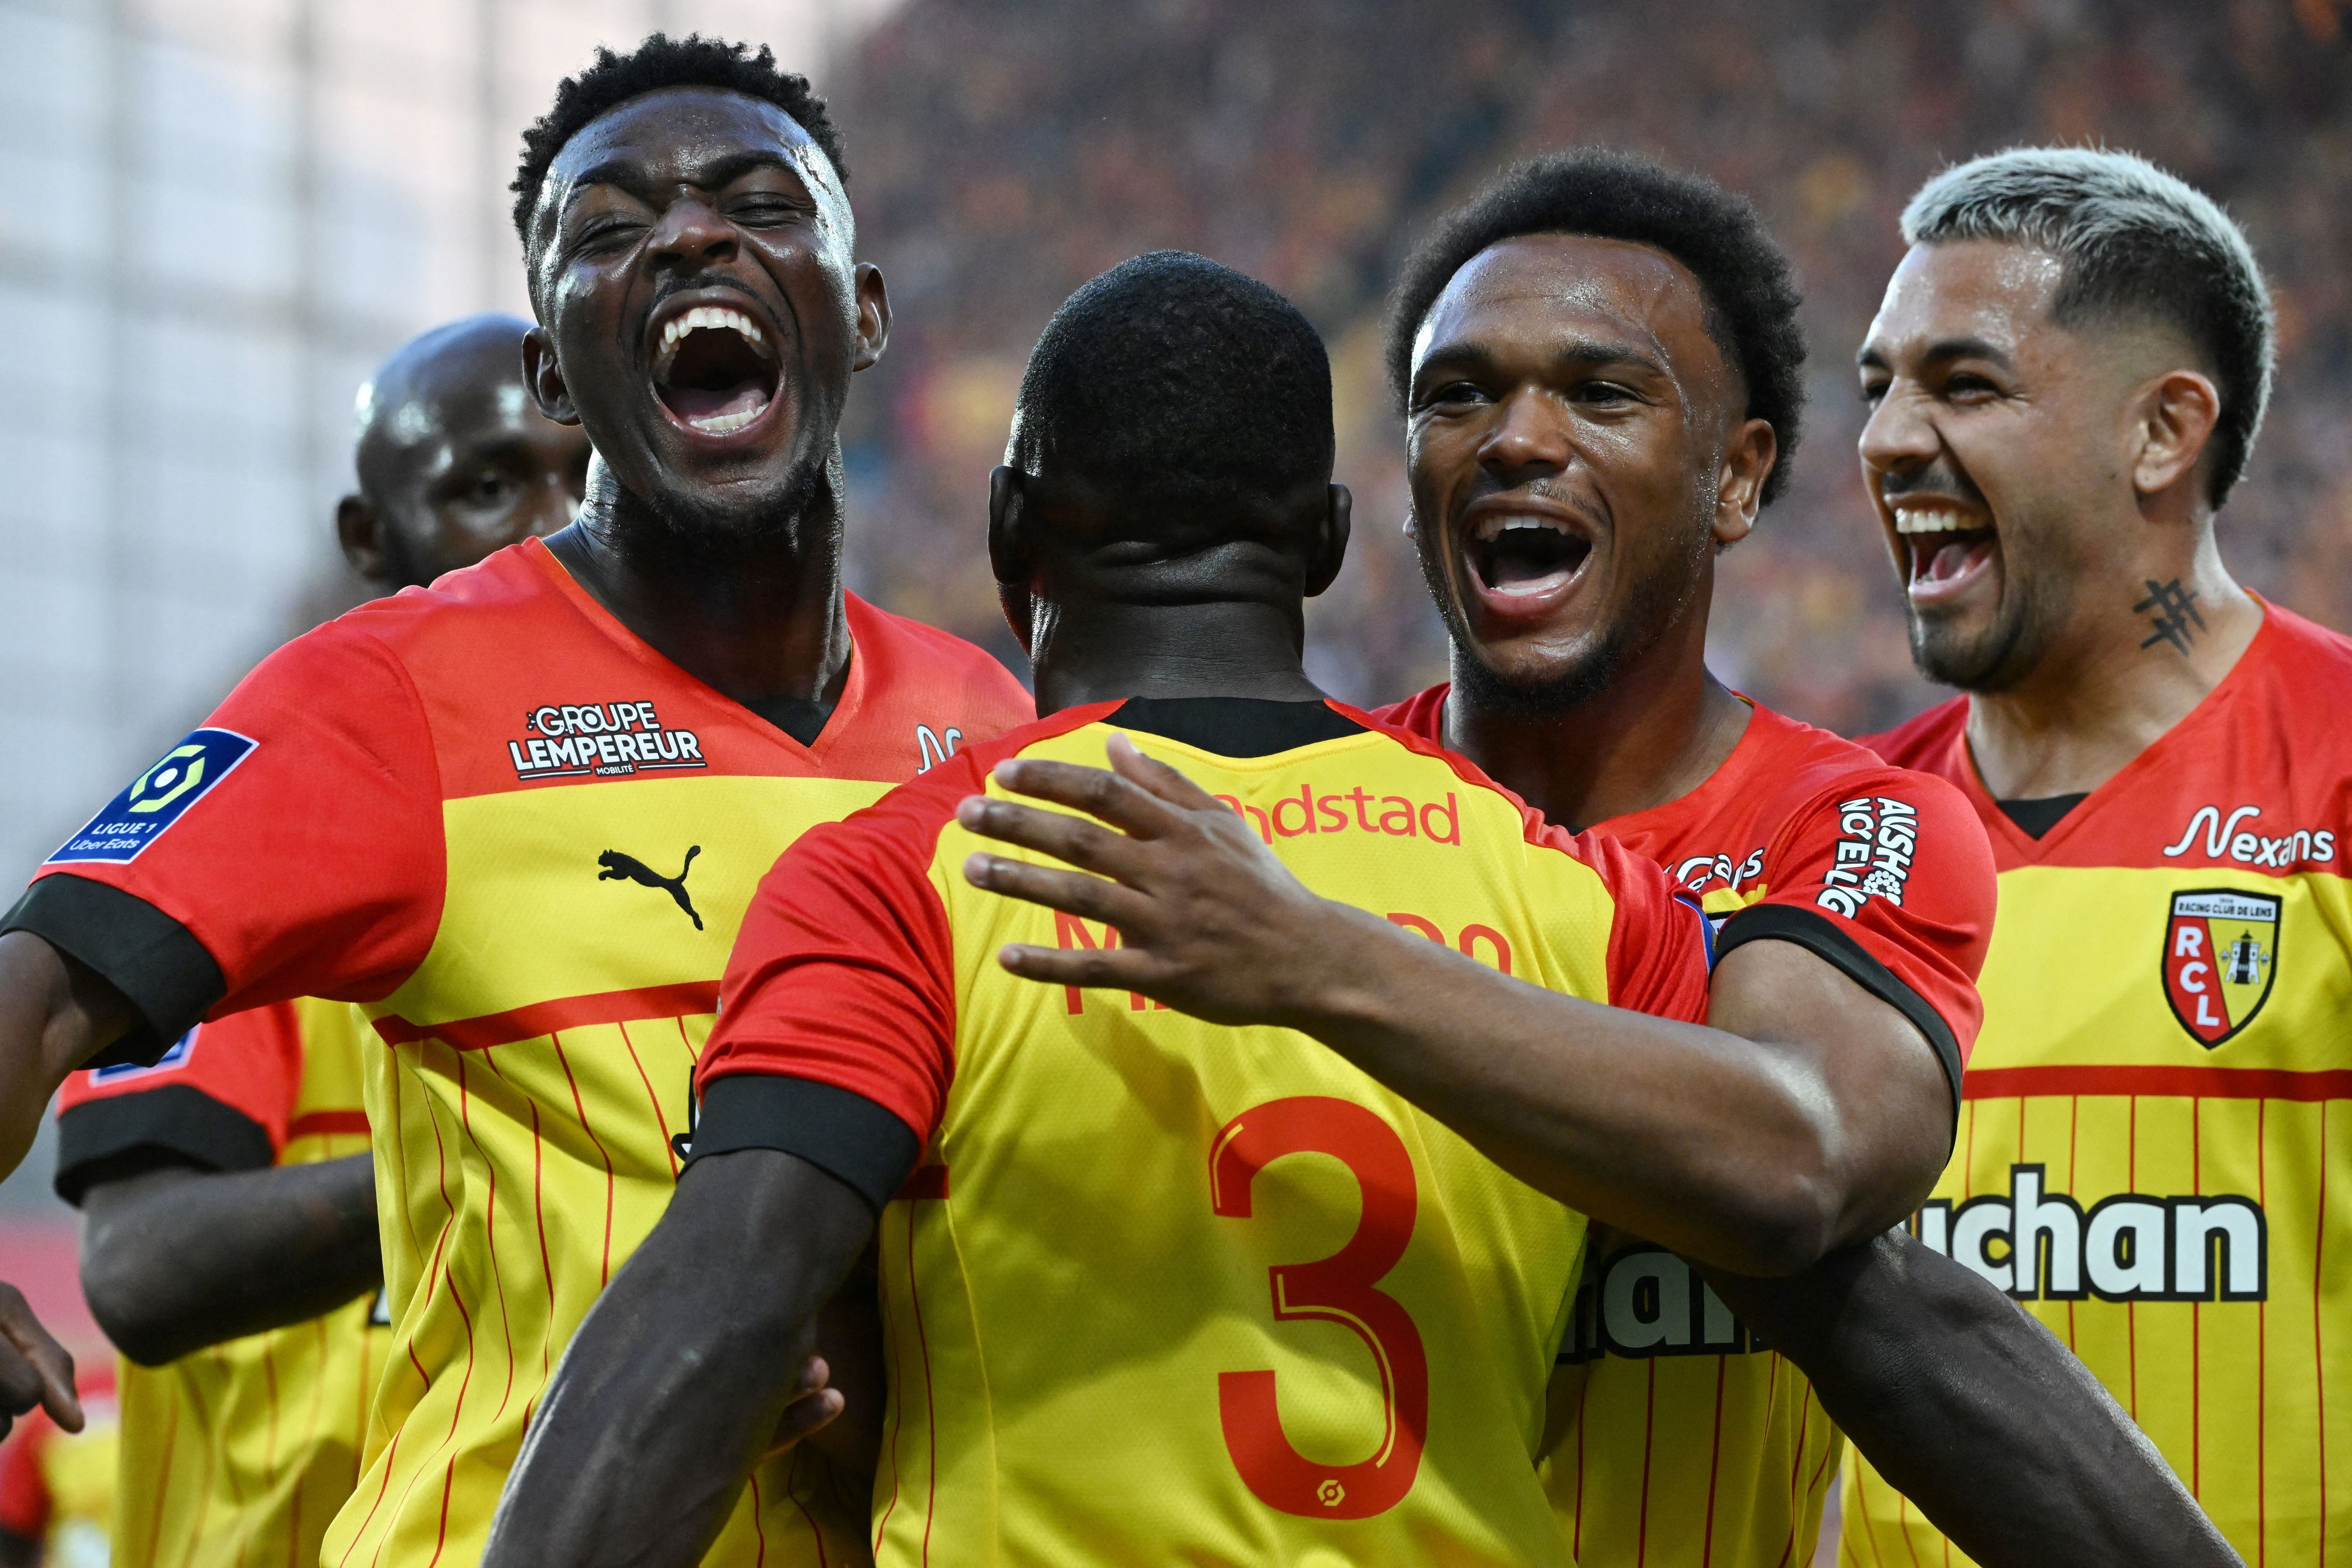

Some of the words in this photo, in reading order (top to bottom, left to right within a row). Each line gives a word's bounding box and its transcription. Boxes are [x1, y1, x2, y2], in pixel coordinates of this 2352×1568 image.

[534, 702, 660, 735] GROUPE
[509, 731, 703, 771] LEMPEREUR
[595, 764, 634, 775] MOBILITÉ
[91, 823, 146, 835] LIGUE
[145, 823, 158, 834] 1
[2163, 805, 2334, 868] Nexans
[69, 840, 107, 851] Uber
[102, 838, 141, 850] Eats
[2179, 902, 2211, 913] RACING
[2213, 904, 2235, 915] CLUB
[2237, 906, 2248, 916] DE
[2250, 906, 2272, 917] LENS
[1209, 1096, 1428, 1520] 3
